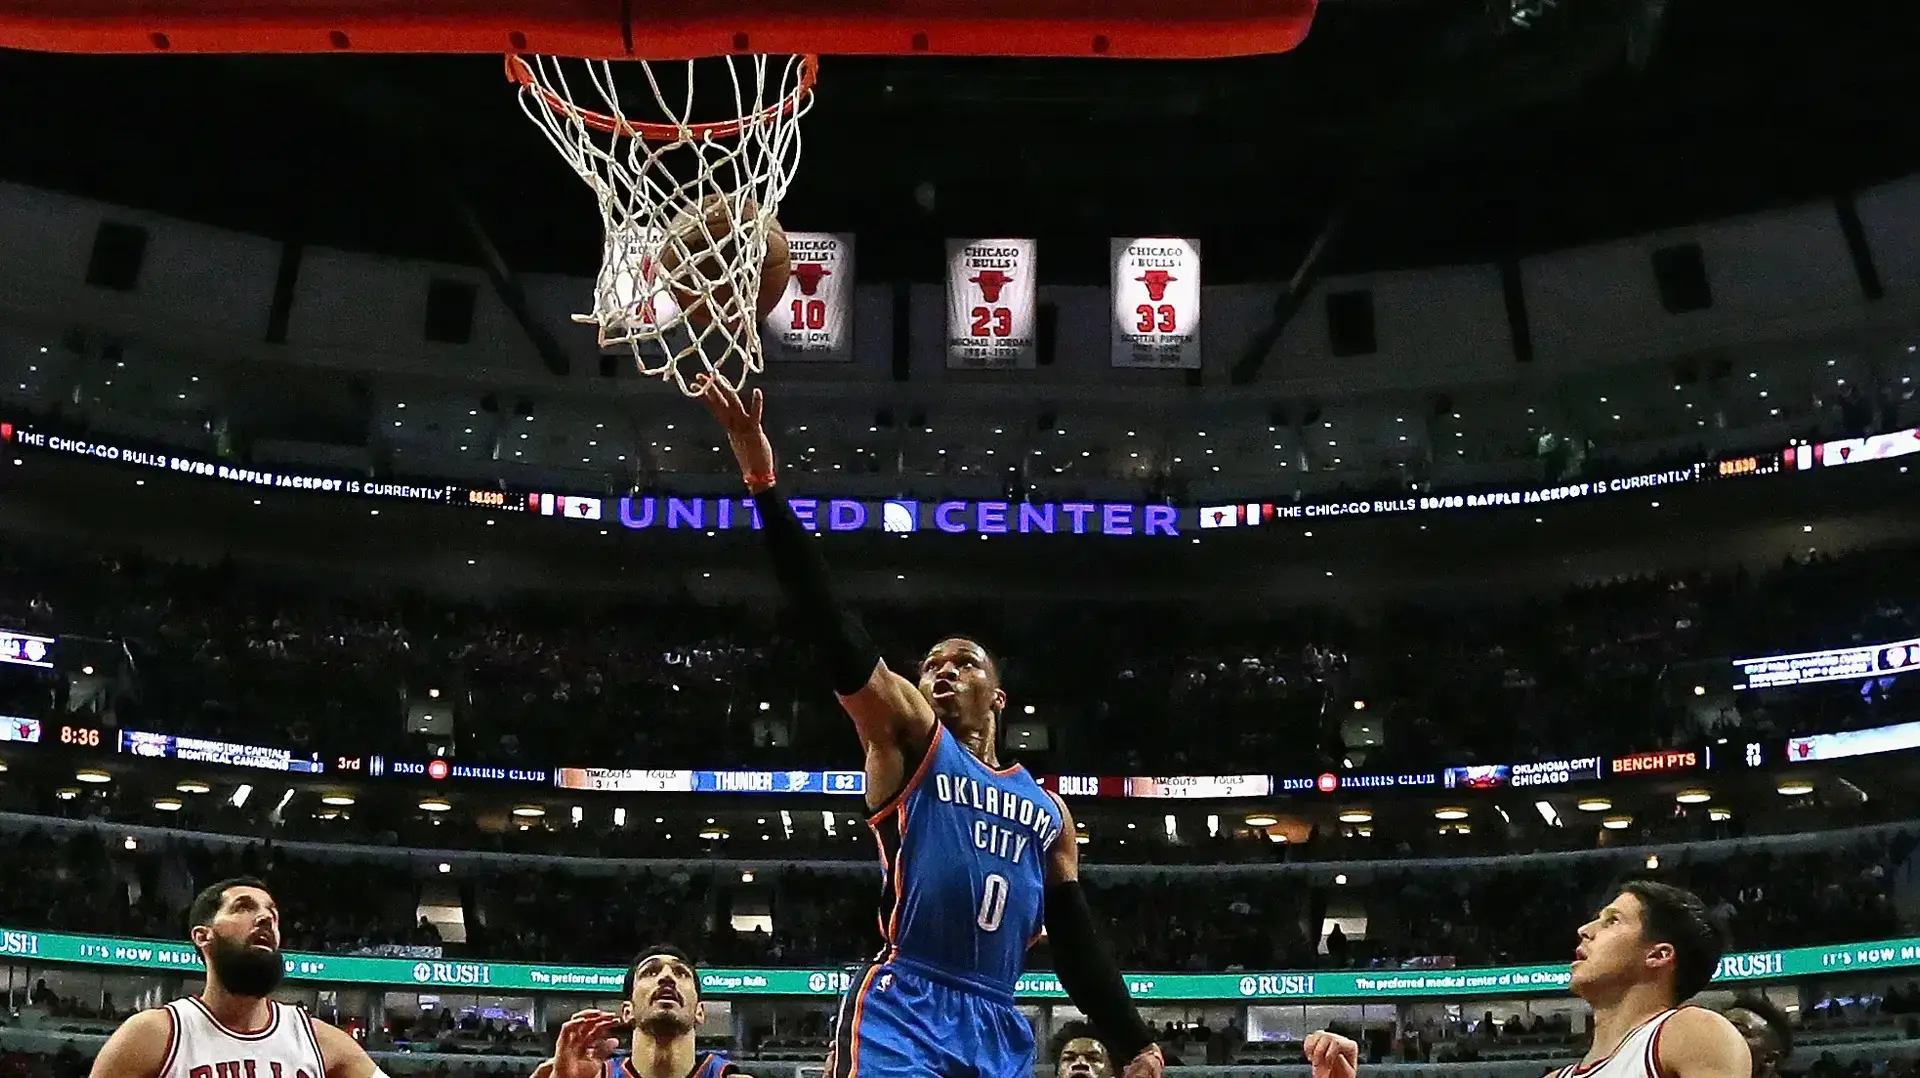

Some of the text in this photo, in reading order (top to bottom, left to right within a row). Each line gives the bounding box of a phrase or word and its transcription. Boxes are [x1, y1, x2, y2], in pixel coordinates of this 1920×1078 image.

[789, 241, 836, 250] HICAGO
[964, 248, 1018, 257] CHICAGO
[1128, 246, 1182, 256] CHICAGO
[791, 252, 828, 260] BULLS
[972, 259, 1010, 268] BULLS
[1138, 258, 1174, 267] BULLS
[791, 300, 826, 330] 10
[971, 306, 1012, 337] 23
[1136, 304, 1176, 332] 33
[17, 430, 44, 447] THE
[49, 436, 118, 460] CHICAGO
[123, 449, 166, 468] BULLS
[170, 457, 215, 476] 50/50
[219, 465, 272, 486] RAFFLE
[276, 474, 342, 492] JACKPOT
[346, 480, 360, 494] IS
[364, 483, 443, 500] CURRENTLY
[1277, 506, 1302, 518] THE
[1306, 502, 1370, 516] CHICAGO
[1374, 498, 1416, 512] BULLS
[1420, 496, 1464, 510] 50/50
[1467, 491, 1520, 507] RAFFLE
[1524, 484, 1590, 504] JACKPOT
[1594, 480, 1607, 494] IS
[1610, 468, 1691, 492] CURRENTLY
[935, 501, 1180, 536] CENTER
[60, 726, 100, 746] 8:36
[338, 756, 360, 770] 3rd
[1512, 757, 1596, 775] OKLAHOMA CITY
[1612, 752, 1696, 773] BENCH PTS
[393, 762, 546, 782] BMO HARRIS CLUB
[1511, 771, 1569, 787] CHICAGO
[713, 772, 772, 791] THUNDER
[1058, 776, 1099, 796] BULLS
[1226, 786, 1232, 794] 2
[1283, 774, 1436, 789] BMO HARRIS CLUB
[935, 773, 1059, 852] OKLAHOMA
[974, 820, 1028, 864] CITY
[977, 873, 1009, 932] 0
[0, 931, 38, 954] USH
[80, 944, 110, 958] IT'S
[116, 947, 152, 962] HOW
[158, 951, 204, 964] MEDIC
[1823, 952, 1852, 966] IT'S
[1857, 948, 1895, 962] HOW
[1724, 953, 1782, 977] RUSH
[433, 966, 490, 984] RUSH
[530, 971, 550, 982] The
[552, 972, 598, 984] preferred
[600, 974, 624, 984] medi
[703, 976, 742, 988] Chicago
[1356, 972, 1570, 990] The preferred medical center of the Chicago
[1015, 980, 1064, 992] DICINE
[1258, 976, 1314, 994] RUSH
